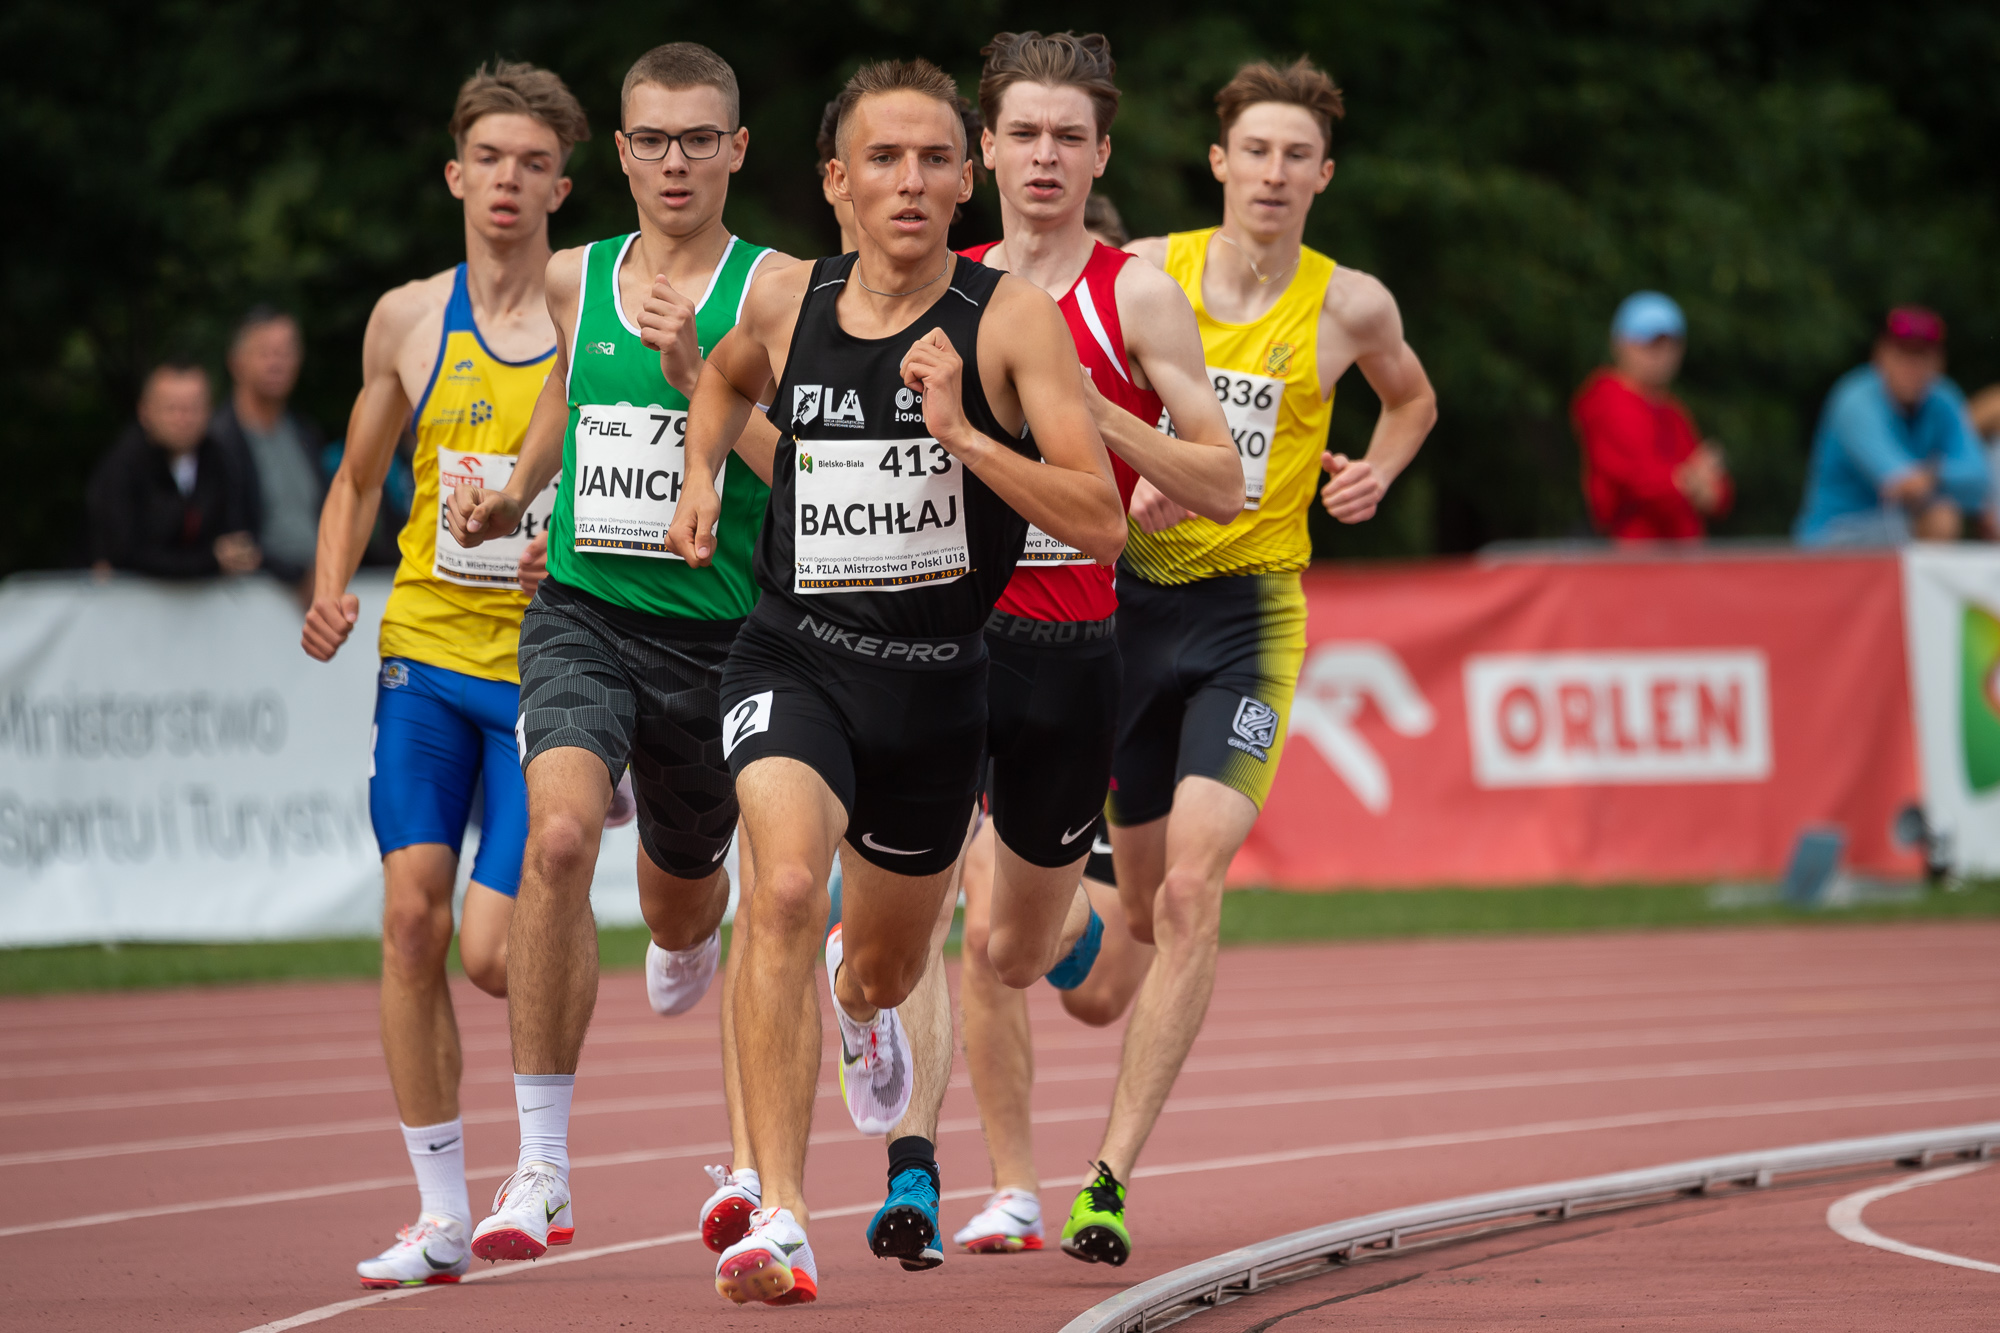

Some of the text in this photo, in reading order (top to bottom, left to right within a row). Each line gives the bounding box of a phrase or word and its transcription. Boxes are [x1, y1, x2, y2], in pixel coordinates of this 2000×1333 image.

[824, 388, 864, 421] LA
[1214, 376, 1274, 411] 836
[589, 421, 632, 437] FUEL
[878, 443, 952, 478] 413
[598, 524, 658, 537] Mistrzostwa
[801, 495, 957, 536] BACHŁAJ
[799, 552, 966, 574] 54. PZLA Mistrzostwa Polski U18
[801, 580, 874, 588] BIELSKO-BIAŁA
[892, 568, 964, 585] 15-17.07.2022
[797, 614, 960, 662] NIKE PRO
[731, 700, 759, 748] 2
[1498, 676, 1743, 757] ORLEN
